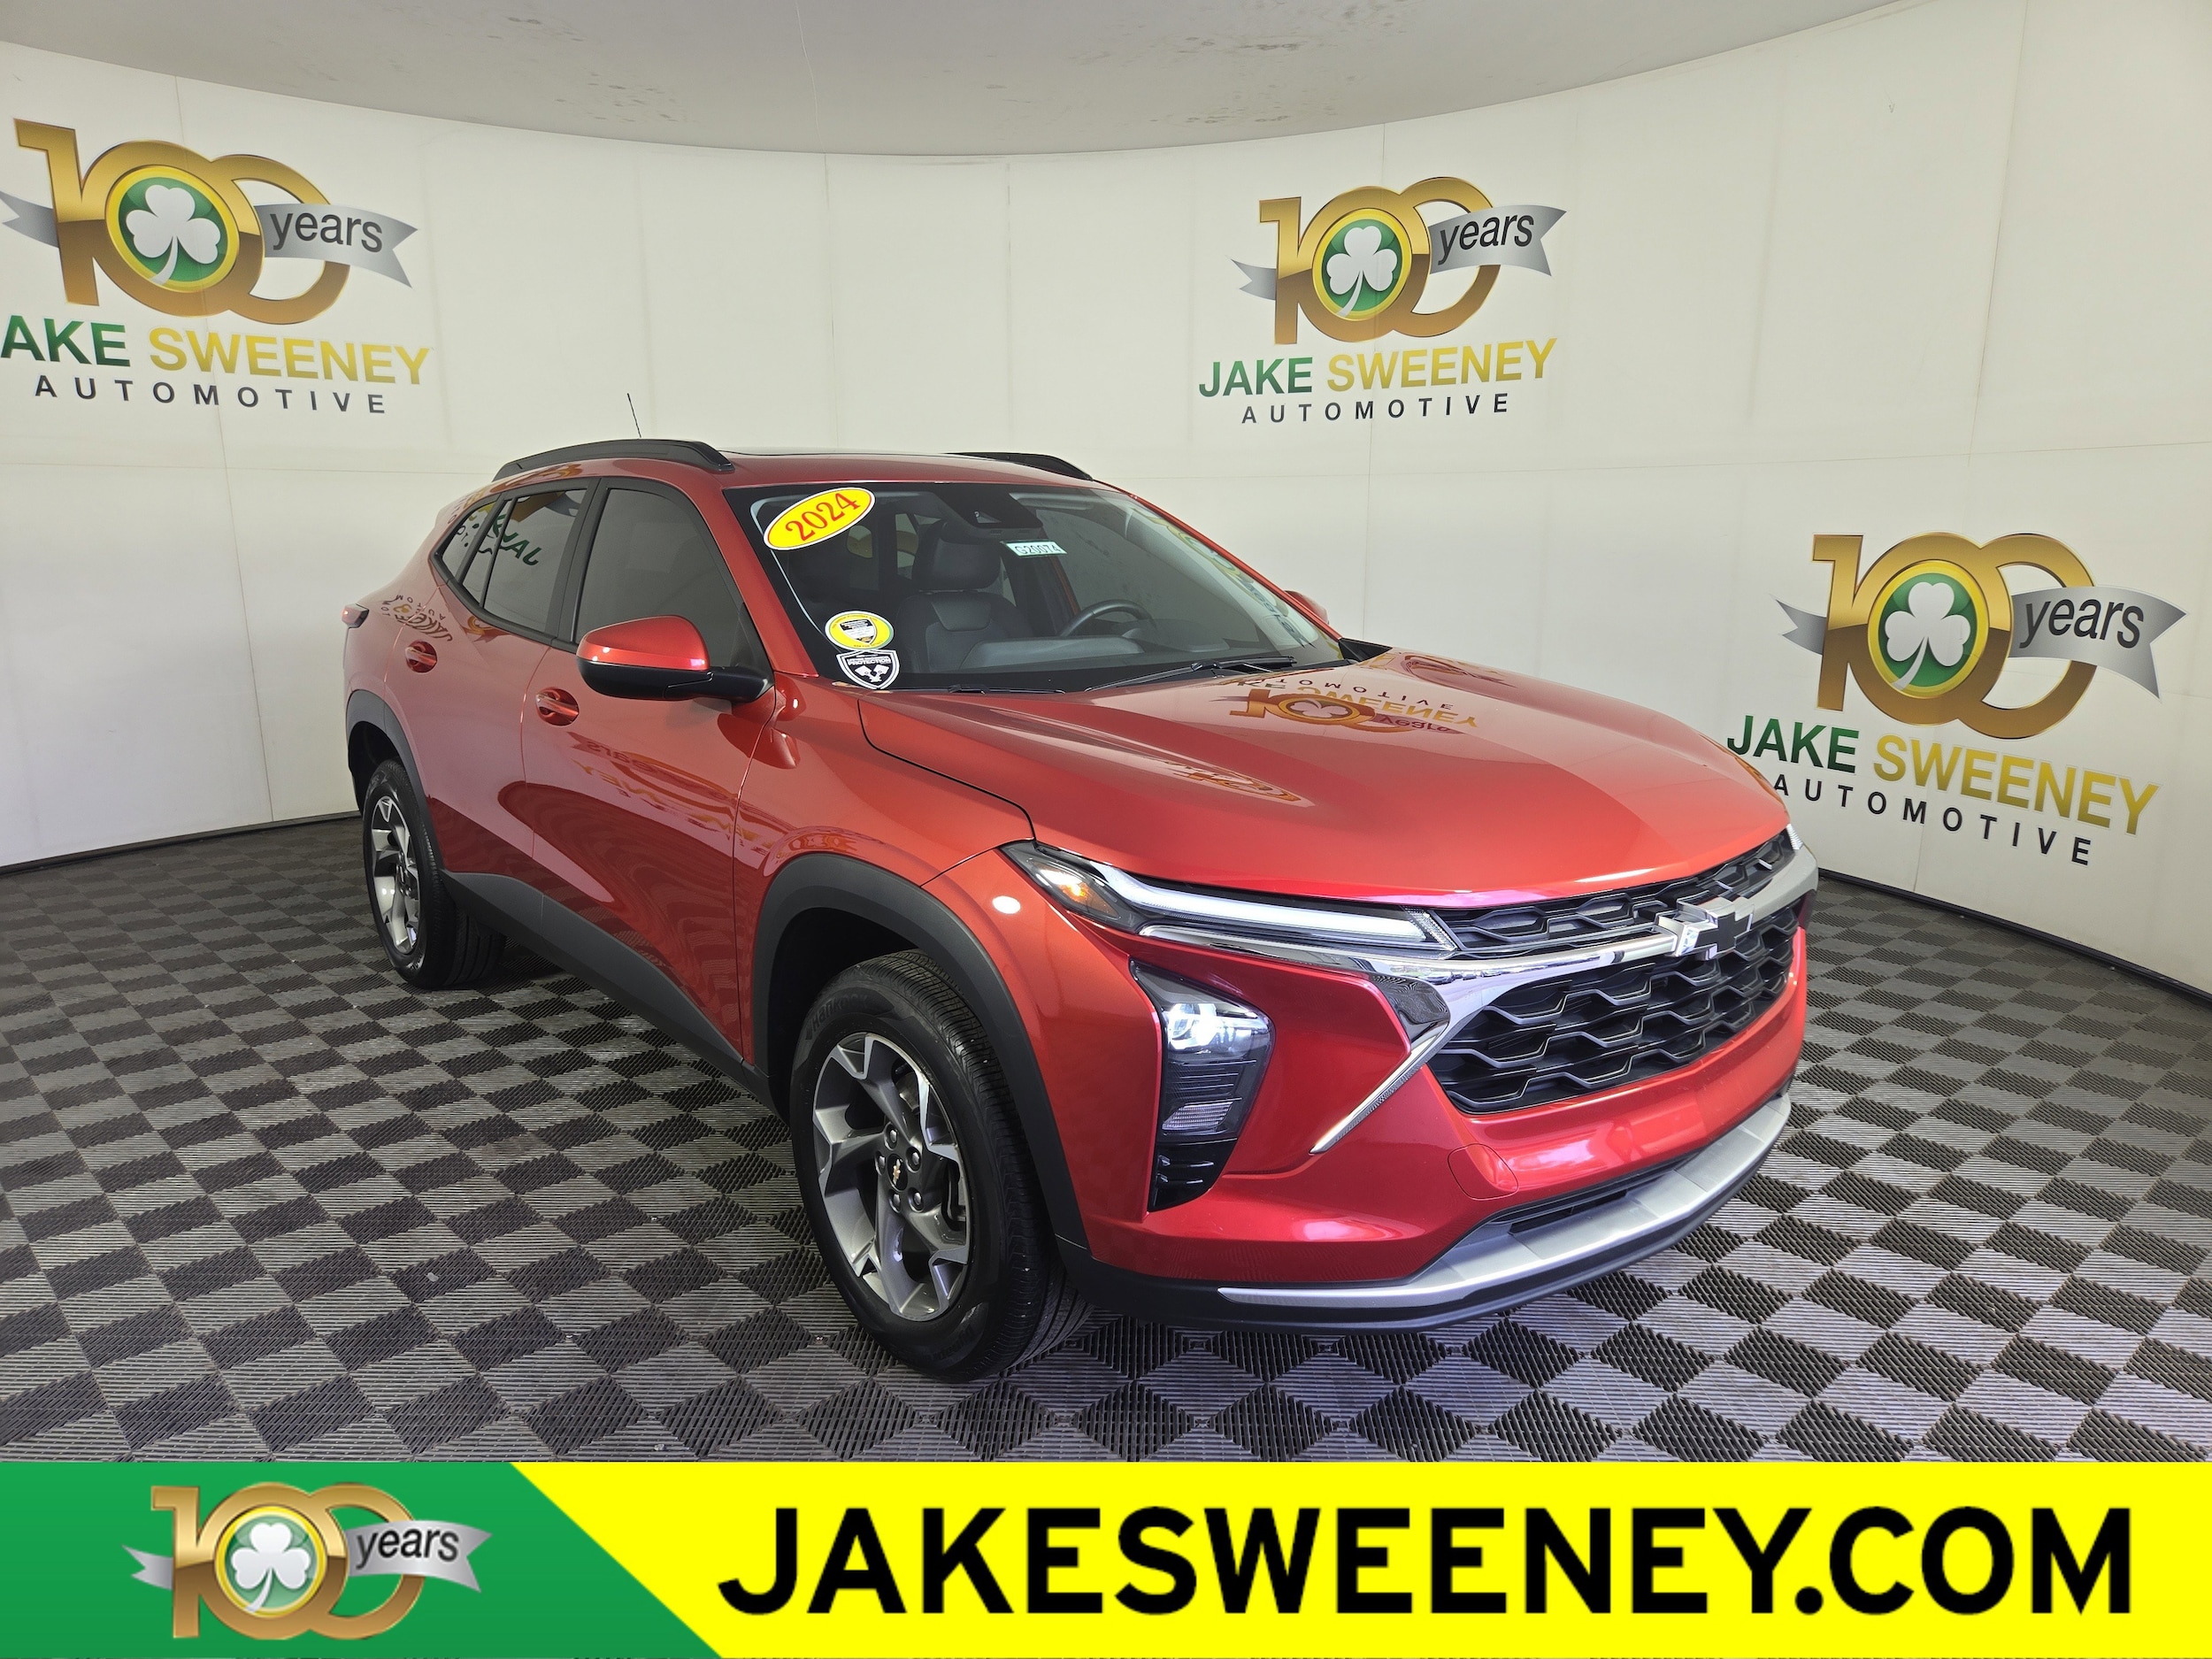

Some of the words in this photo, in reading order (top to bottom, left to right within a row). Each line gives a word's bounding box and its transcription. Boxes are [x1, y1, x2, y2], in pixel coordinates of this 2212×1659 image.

[269, 211, 383, 253] years
[1438, 213, 1534, 265] years
[149, 326, 430, 385] SWEENEY
[1199, 357, 1312, 396] JAKE
[1327, 337, 1558, 392] SWEENEY
[35, 374, 385, 413] AUTOMOTIVE
[1241, 393, 1508, 424] AUTOMOTIVE
[785, 492, 860, 541] 2024
[2020, 598, 2144, 649] years
[1727, 715, 1860, 773] JAKE
[1873, 734, 2160, 835] SWEENEY
[1774, 774, 2091, 866] AUTOMOTIVE
